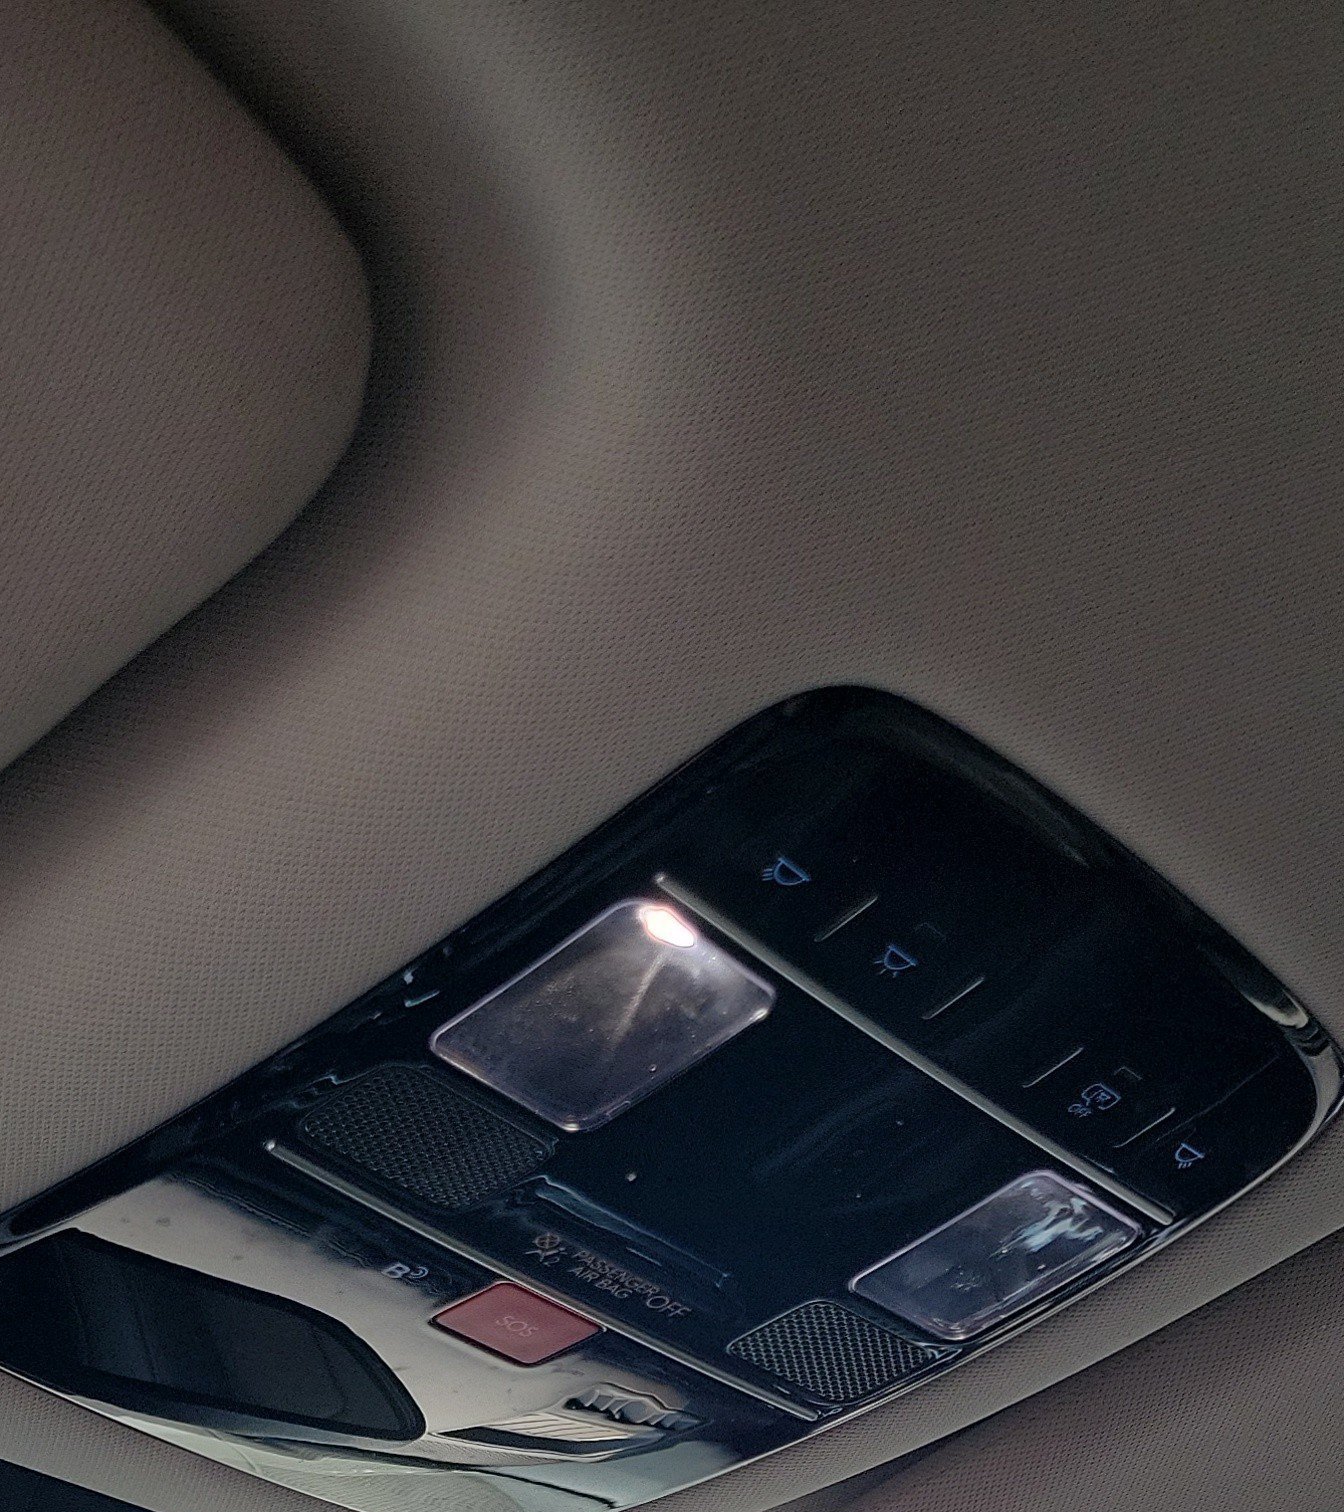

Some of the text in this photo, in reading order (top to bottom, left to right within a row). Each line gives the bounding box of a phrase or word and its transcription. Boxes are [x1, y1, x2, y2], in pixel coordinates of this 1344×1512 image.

[567, 1266, 633, 1299] AIR BAG
[571, 1250, 661, 1297] PASSENGER
[646, 1295, 693, 1318] OFF
[495, 1315, 538, 1338] SOS
